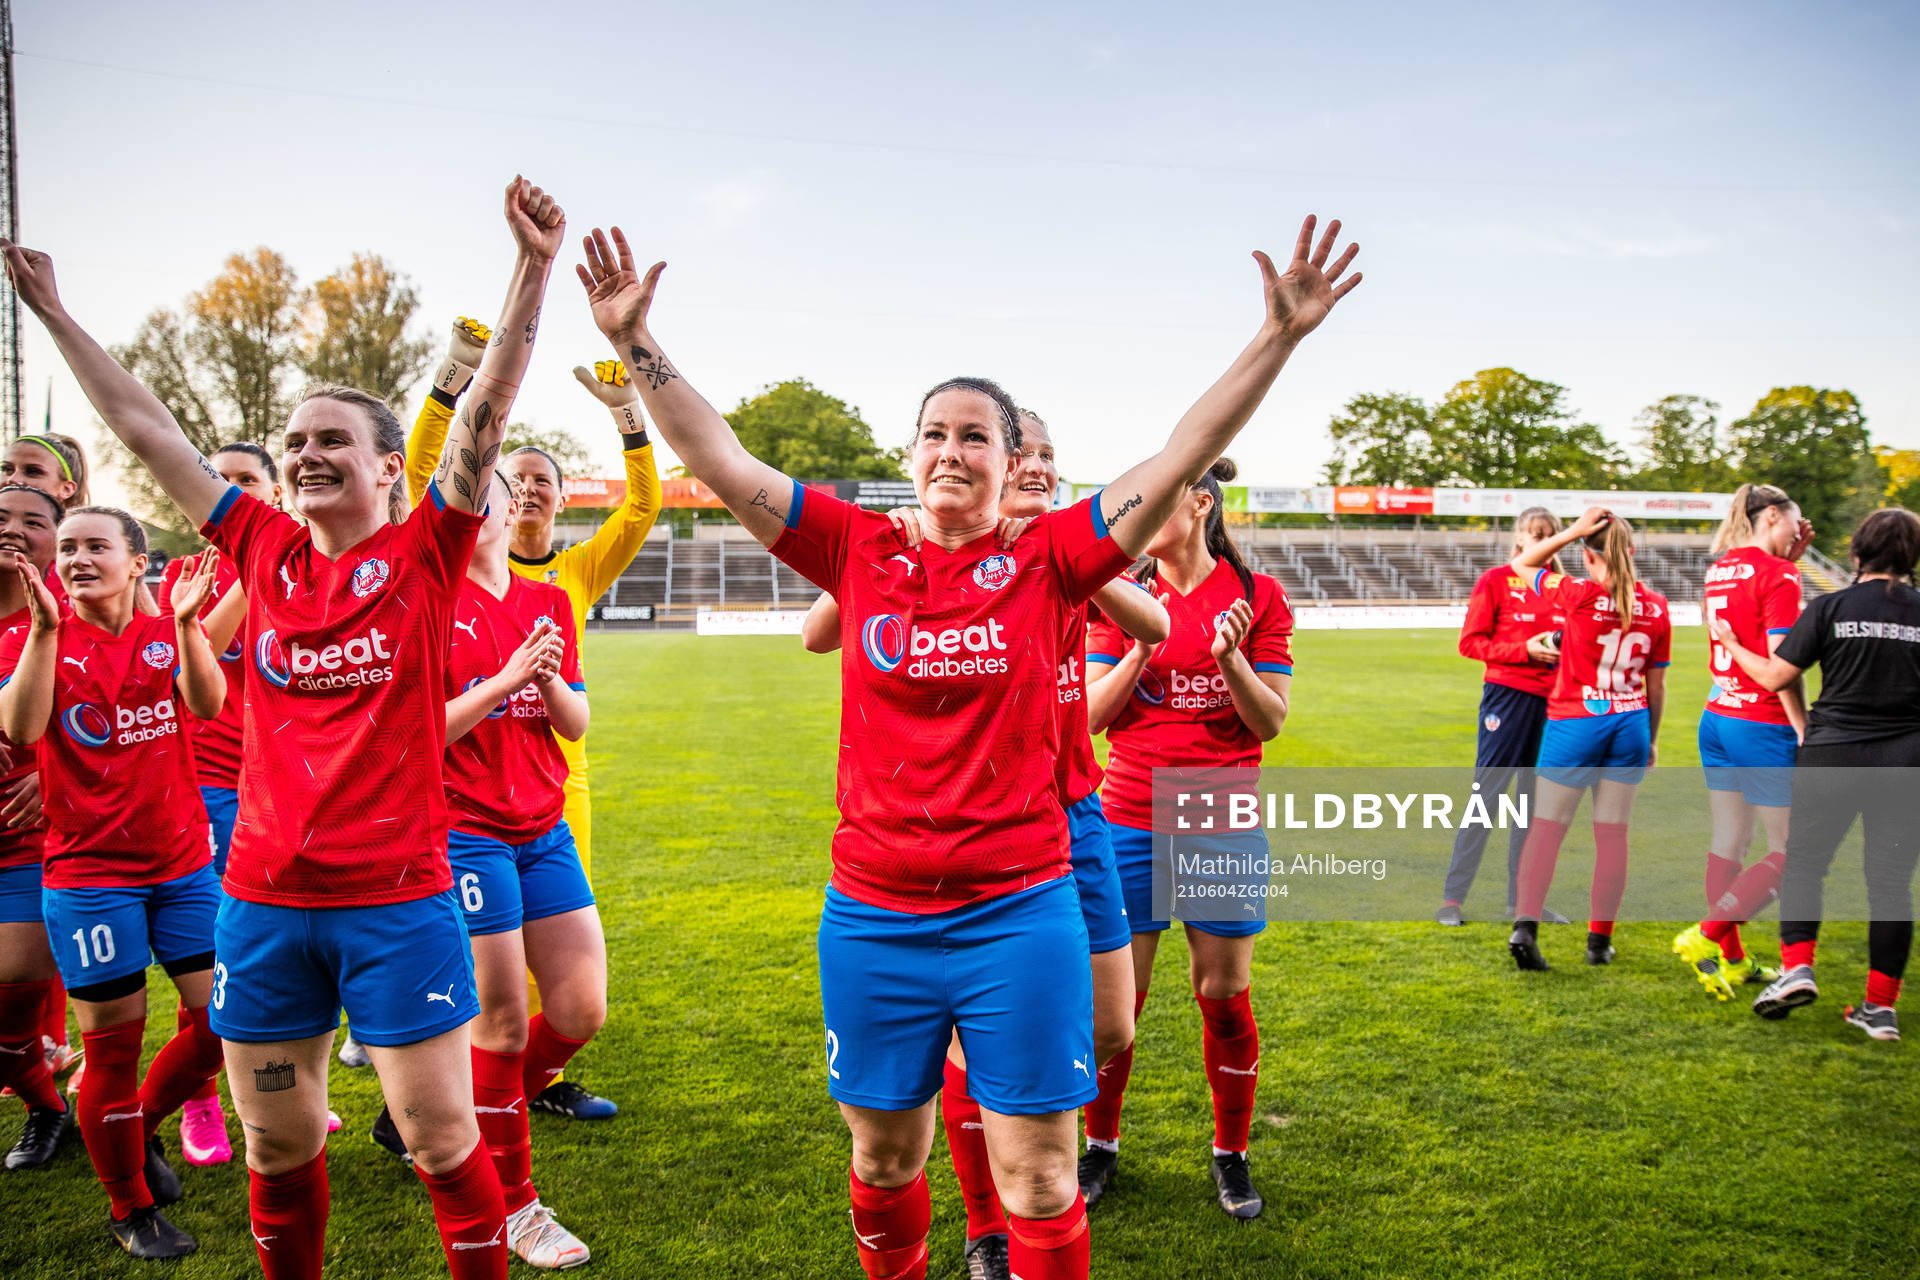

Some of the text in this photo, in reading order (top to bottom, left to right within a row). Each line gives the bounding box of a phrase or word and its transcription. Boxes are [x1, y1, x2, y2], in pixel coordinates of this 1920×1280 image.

[291, 627, 391, 675] beat
[910, 618, 1007, 657] beat
[297, 667, 393, 691] diabetes
[907, 655, 1009, 678] diabetes
[1597, 627, 1652, 695] 16
[1170, 669, 1229, 694] bea
[116, 698, 175, 730] bea
[460, 872, 484, 912] 6
[72, 923, 116, 968] 10
